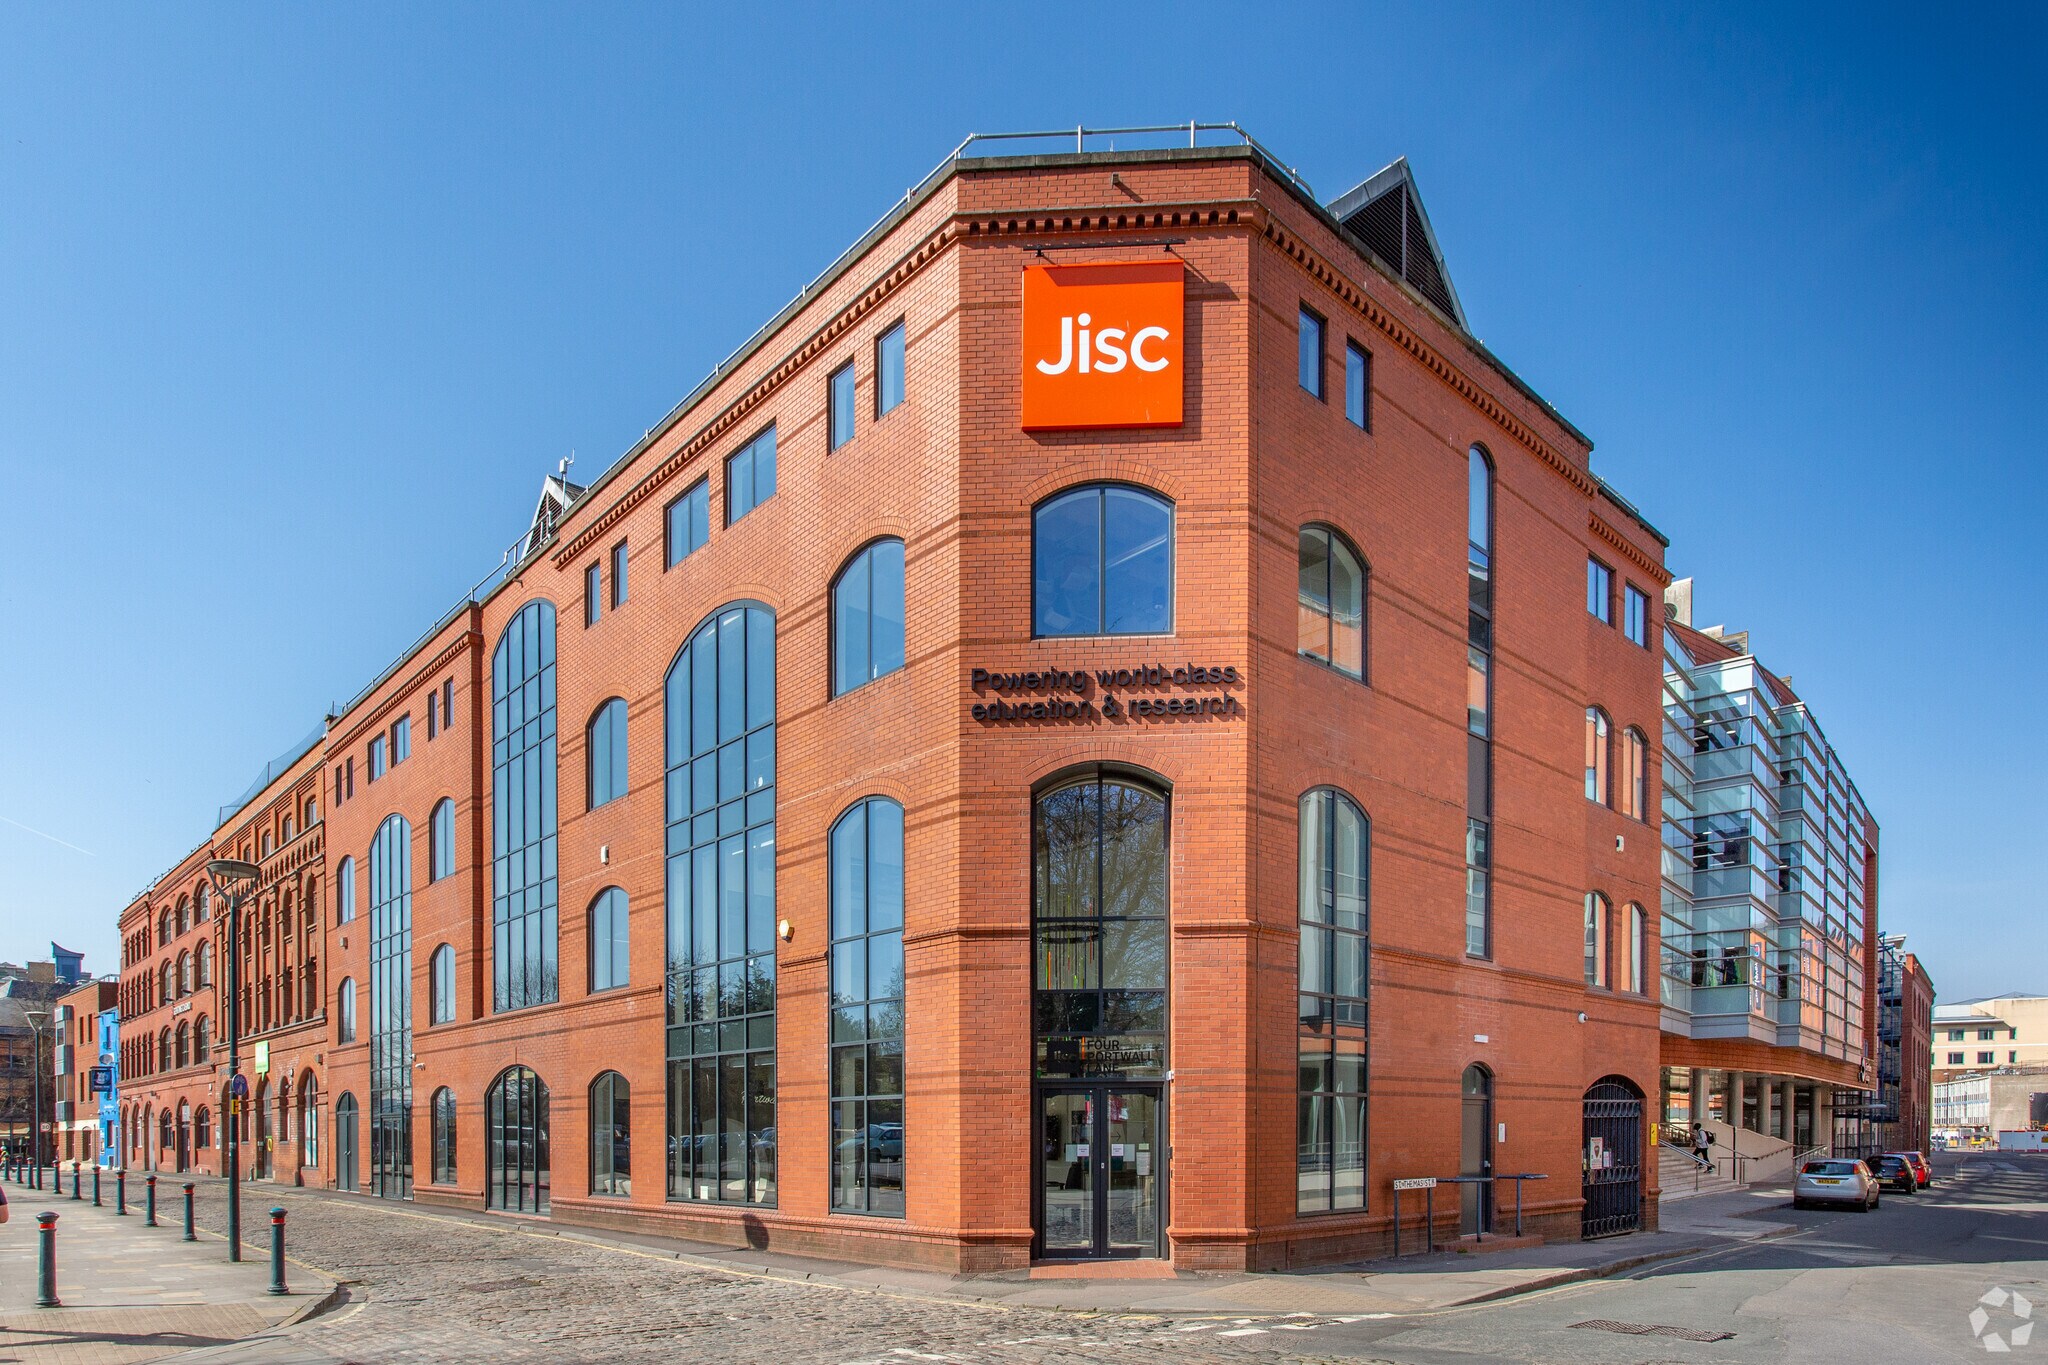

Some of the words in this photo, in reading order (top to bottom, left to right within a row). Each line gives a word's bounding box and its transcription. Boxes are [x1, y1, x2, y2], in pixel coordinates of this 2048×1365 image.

[1036, 312, 1170, 375] Jisc
[971, 665, 1087, 693] Powering
[1095, 661, 1237, 687] world-class
[971, 697, 1092, 721] education
[1101, 693, 1119, 718] &
[1128, 691, 1237, 717] research
[1087, 1040, 1120, 1050] FOUR
[1087, 1051, 1153, 1061] PORTWALL
[1087, 1063, 1119, 1073] LANE
